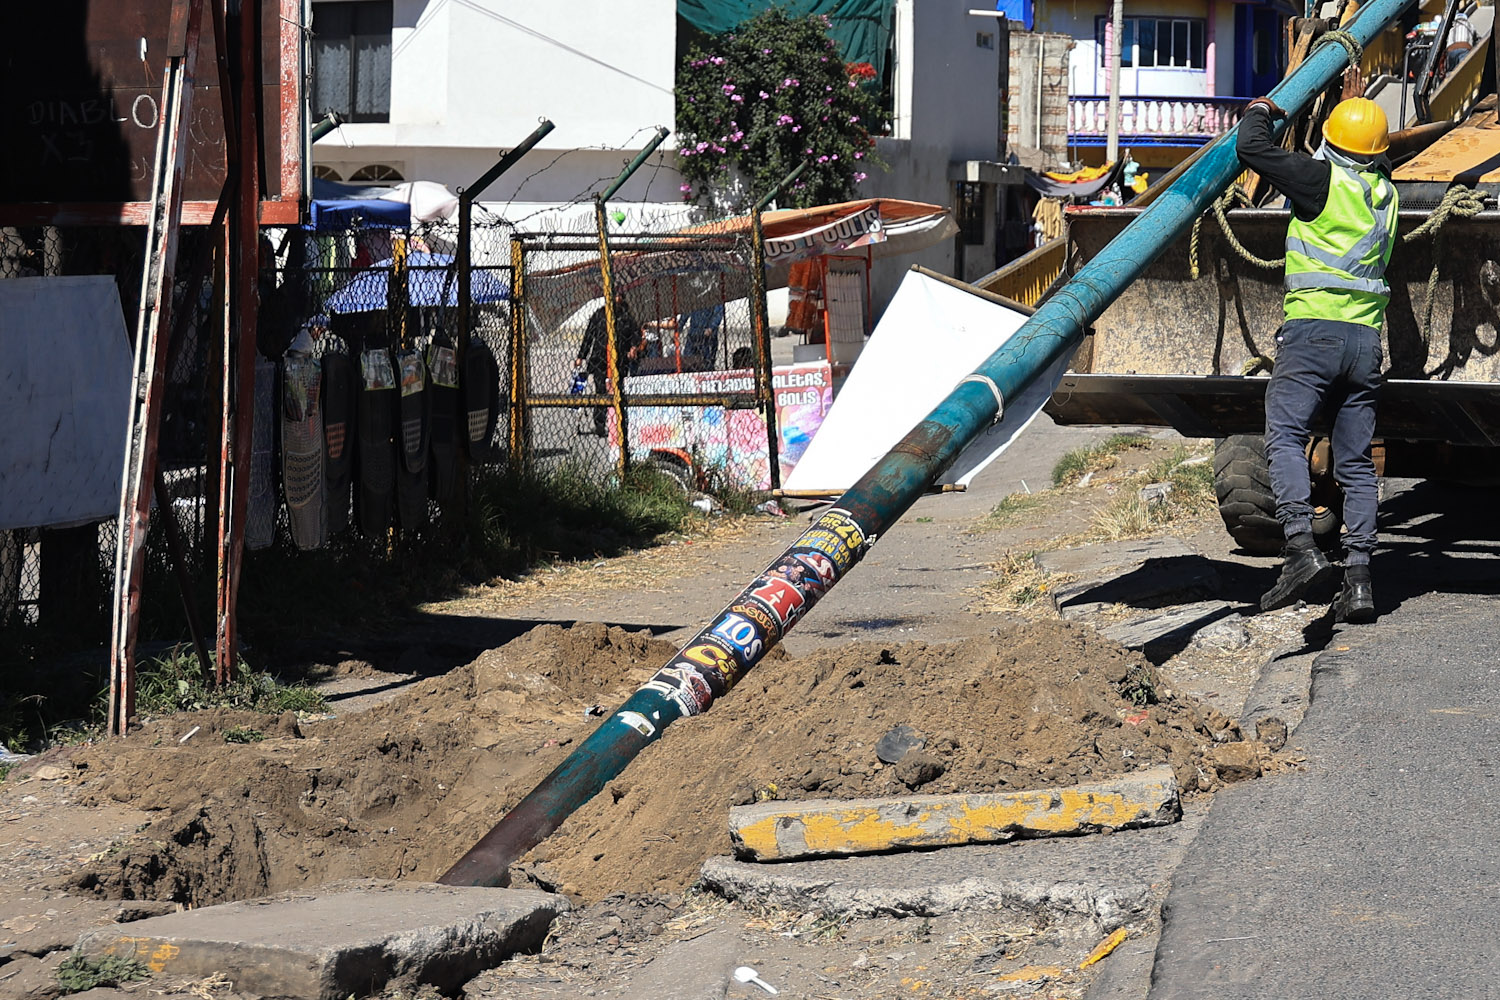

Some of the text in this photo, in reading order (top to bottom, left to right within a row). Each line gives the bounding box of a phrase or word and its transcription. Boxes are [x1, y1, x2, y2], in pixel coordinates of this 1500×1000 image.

[28, 94, 158, 129] DIABLO
[777, 391, 817, 407] BOLIS
[819, 516, 841, 527] DIC
[804, 530, 840, 546] SUPER
[796, 539, 812, 548] DE
[815, 540, 835, 554] FIN
[715, 613, 763, 661] LOS
